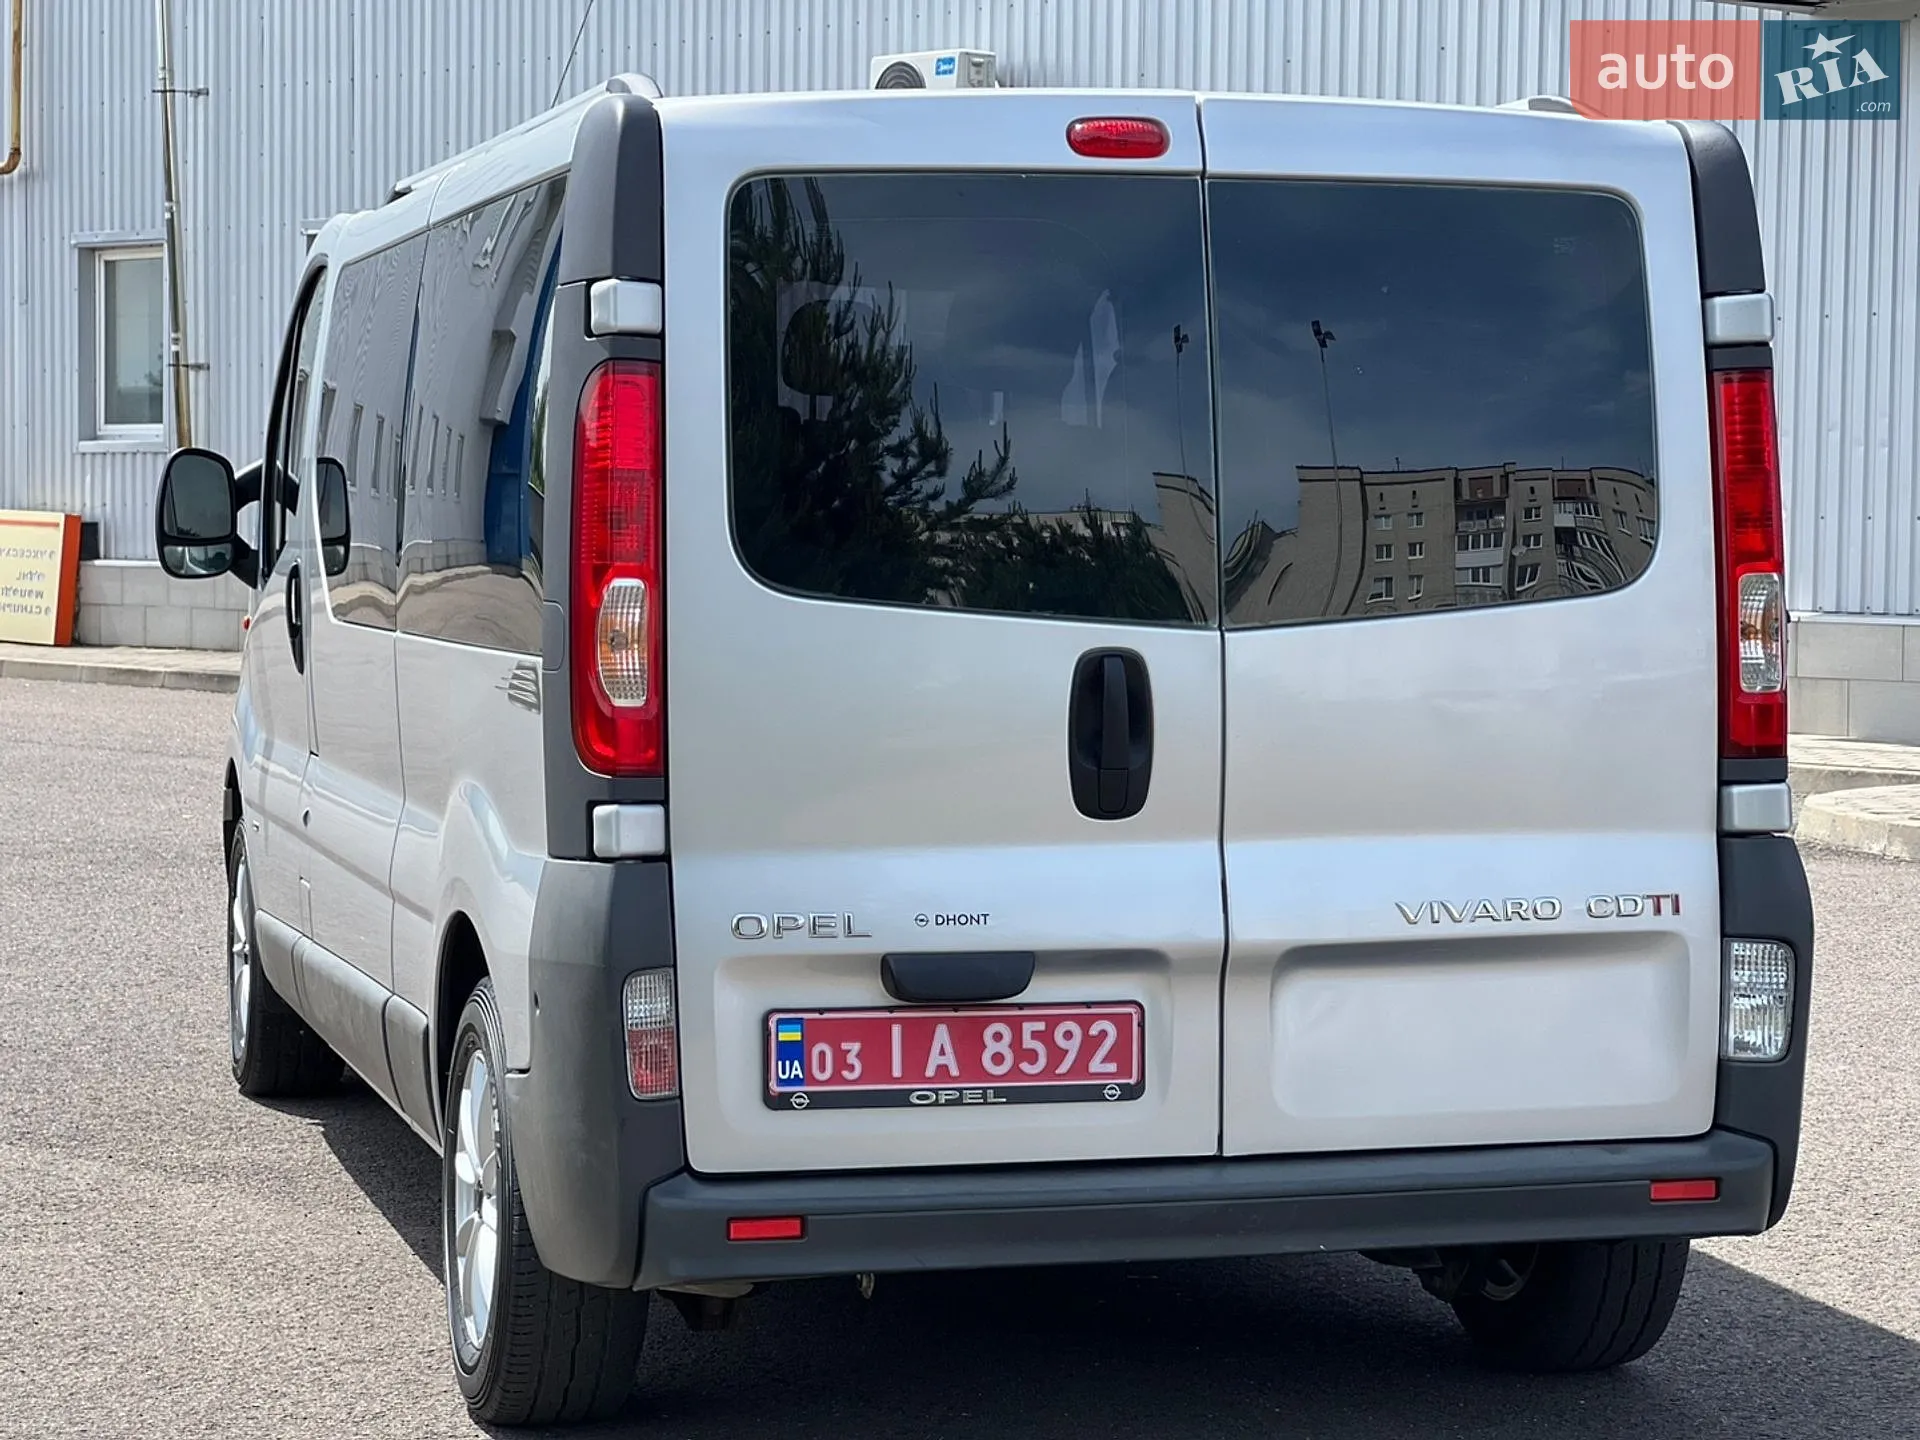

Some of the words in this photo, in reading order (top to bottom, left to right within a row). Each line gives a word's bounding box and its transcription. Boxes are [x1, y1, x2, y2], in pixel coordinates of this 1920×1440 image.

[934, 912, 990, 927] DHONT
[1395, 895, 1563, 925] VIVARO
[1586, 893, 1681, 919] CDTI
[730, 911, 872, 941] OPEL
[778, 1059, 804, 1081] UA
[811, 1042, 863, 1083] 03
[890, 1022, 961, 1079] IA
[981, 1019, 1118, 1077] 8592
[909, 1089, 1007, 1105] OPEL
